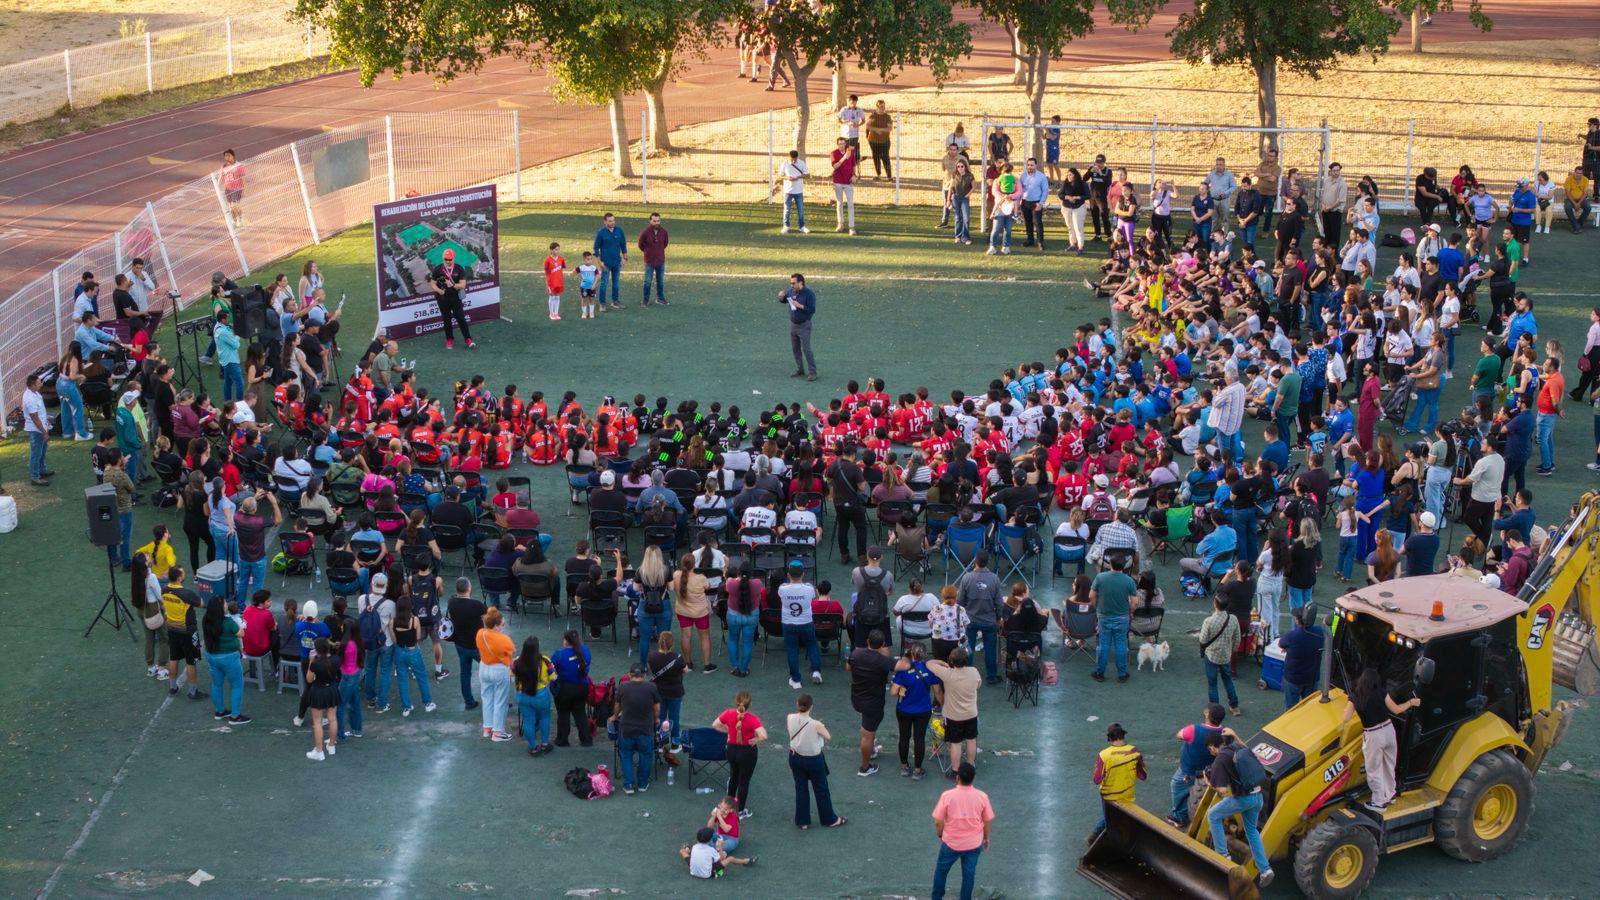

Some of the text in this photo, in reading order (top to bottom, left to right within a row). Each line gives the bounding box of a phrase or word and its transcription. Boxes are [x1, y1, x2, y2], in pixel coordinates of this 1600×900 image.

[381, 202, 417, 217] REHABILITACIÓN
[418, 201, 426, 210] DEL
[426, 199, 443, 208] CENTRO
[432, 206, 456, 216] Quintas
[1064, 485, 1083, 503] 57
[789, 602, 803, 617] 9
[1527, 613, 1550, 649] CAT
[1251, 742, 1279, 761] CAT
[1323, 759, 1345, 783] 416
